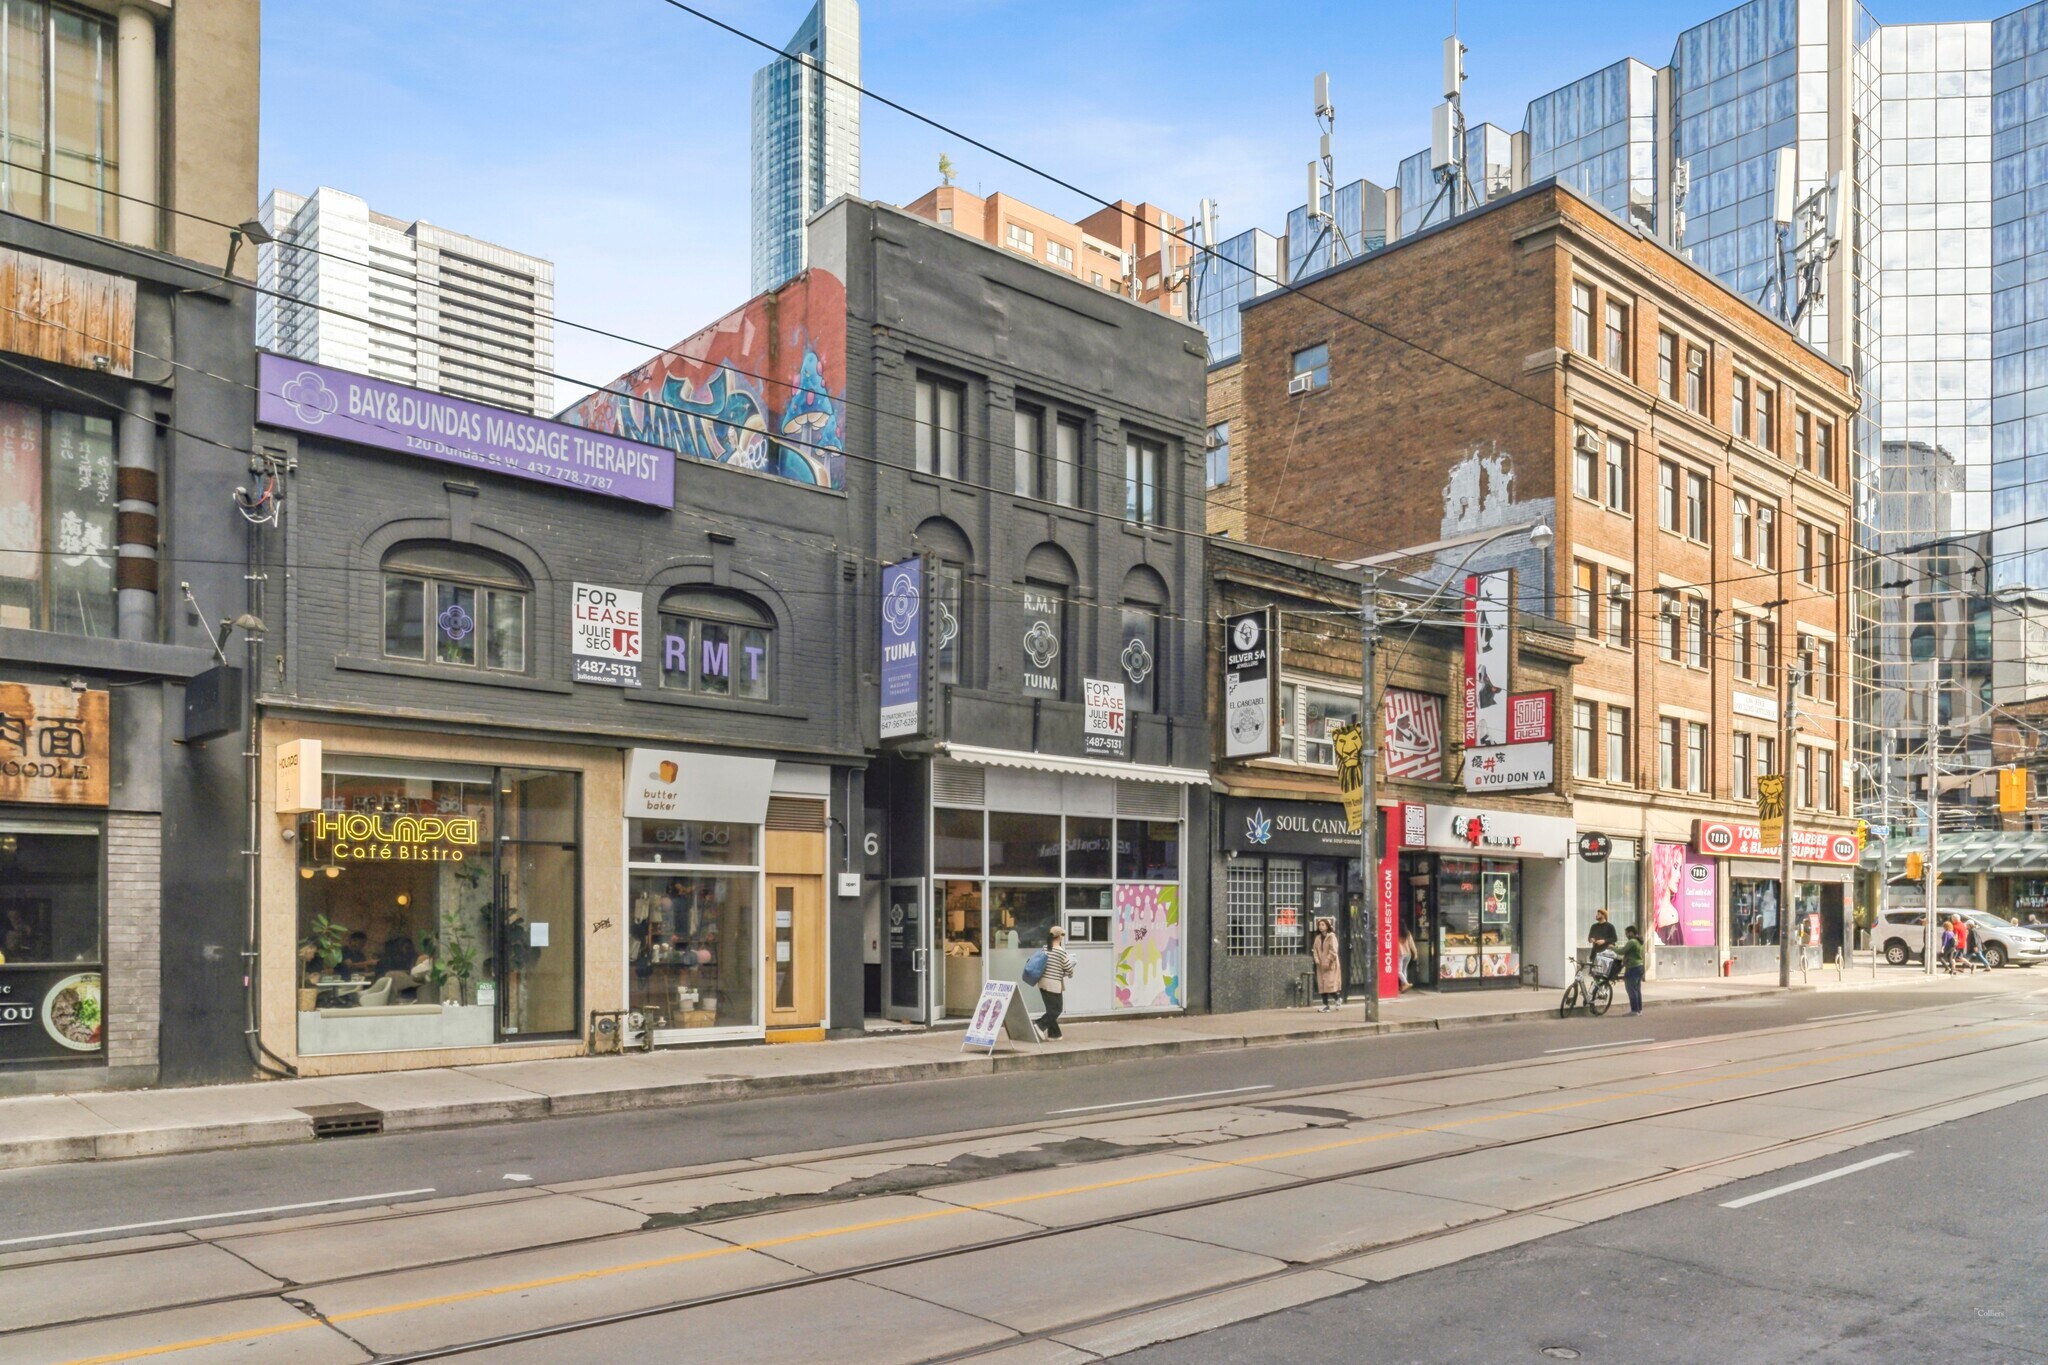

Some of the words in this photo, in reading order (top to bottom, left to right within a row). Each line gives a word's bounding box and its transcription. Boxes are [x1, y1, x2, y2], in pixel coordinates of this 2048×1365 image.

[349, 384, 481, 442] BAY&DUNDAS
[487, 416, 569, 462] MASSAGE
[574, 437, 659, 481] THERAPIST
[407, 435, 431, 450] 120
[435, 441, 485, 463] Dundas
[488, 453, 502, 466] St
[505, 456, 519, 469] W
[527, 461, 613, 489] 437.778.7787
[577, 587, 617, 607] FOR
[576, 604, 639, 627] LEASE
[579, 624, 611, 639] JULIE
[586, 637, 611, 651] SEO
[884, 641, 917, 663] TUINA
[1229, 652, 1253, 664] SILVER
[581, 660, 637, 678] 487-5131
[577, 673, 617, 683] julieseo.com
[1024, 673, 1058, 691] TUINA
[1087, 682, 1110, 695] FOR
[1087, 695, 1123, 709] LEASE
[1230, 701, 1235, 709] EL
[1237, 698, 1264, 708] CASCABEL
[1466, 688, 1475, 718] FLOOR
[1089, 710, 1108, 719] JULIE
[1093, 719, 1108, 729] SEO
[1466, 720, 1475, 739] 2ND
[1089, 737, 1121, 749] 487-5131
[1484, 775, 1504, 785] YOU
[1508, 772, 1528, 782] DON
[1533, 770, 1545, 780] YA
[644, 788, 677, 799] butter
[647, 800, 675, 810] baker
[1276, 815, 1309, 832] SOUL
[1711, 833, 1728, 844] TBBS
[1792, 832, 1828, 846] BARBER
[334, 844, 391, 859] Café
[400, 846, 463, 861] Bistro
[1740, 841, 1748, 854] &
[1791, 846, 1827, 859] SUPPLY
[1836, 844, 1852, 855] TBBS
